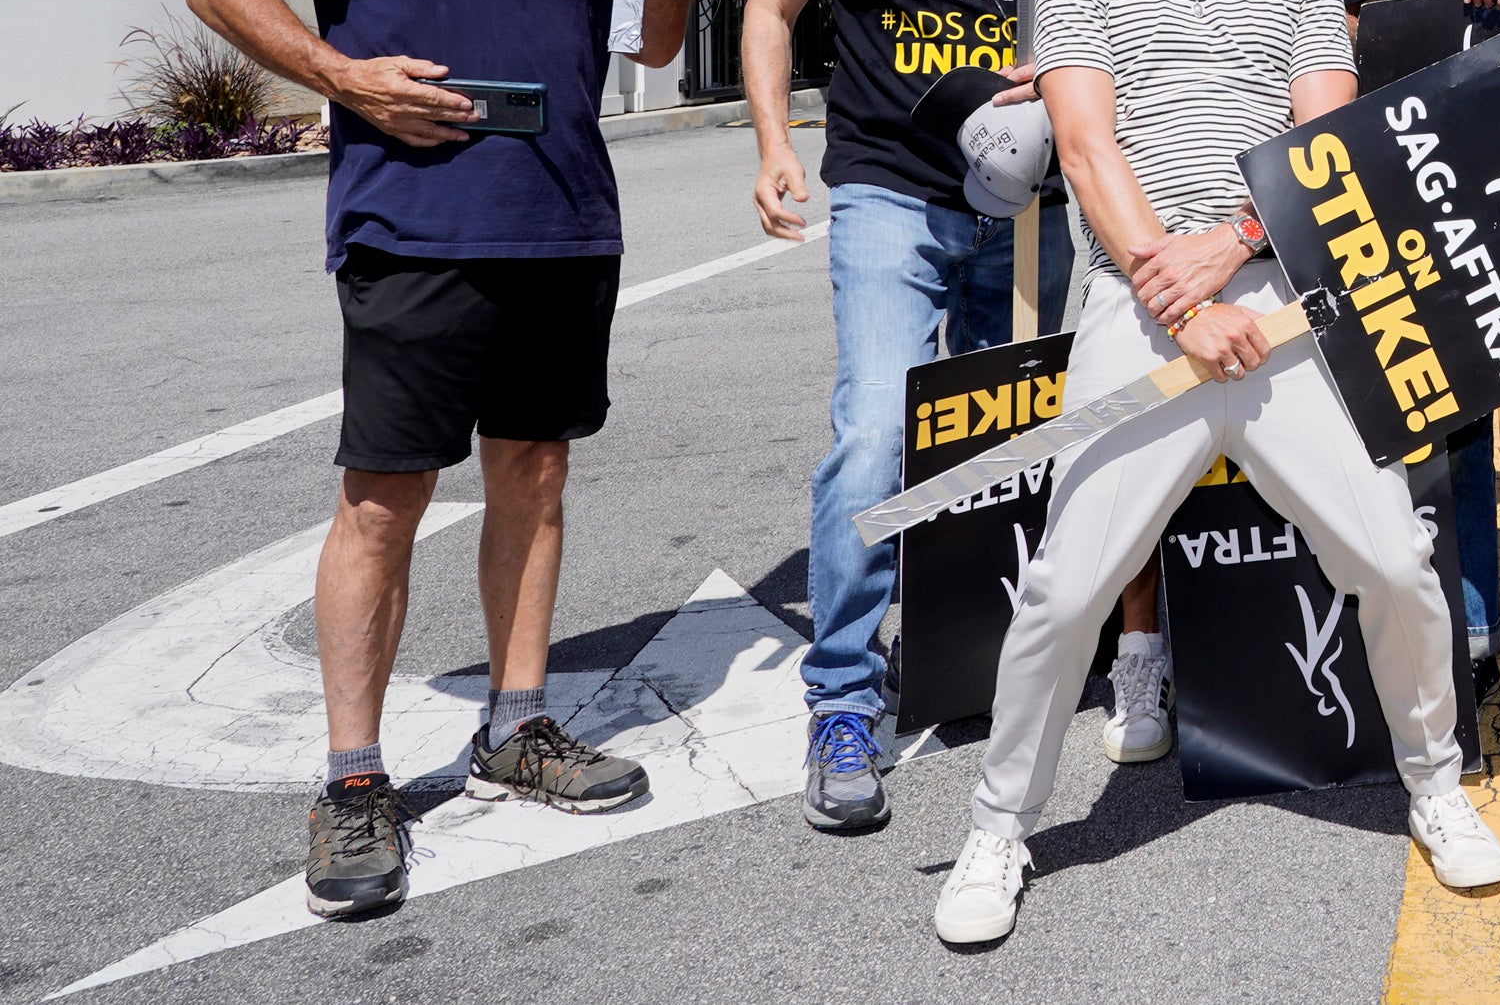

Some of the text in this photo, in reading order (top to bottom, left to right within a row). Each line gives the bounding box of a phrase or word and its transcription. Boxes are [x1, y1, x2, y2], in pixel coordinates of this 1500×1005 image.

[881, 9, 966, 41] #ADS
[1288, 132, 1461, 434] STRIKE!
[1397, 229, 1441, 291] ON
[344, 778, 371, 790] FILA
